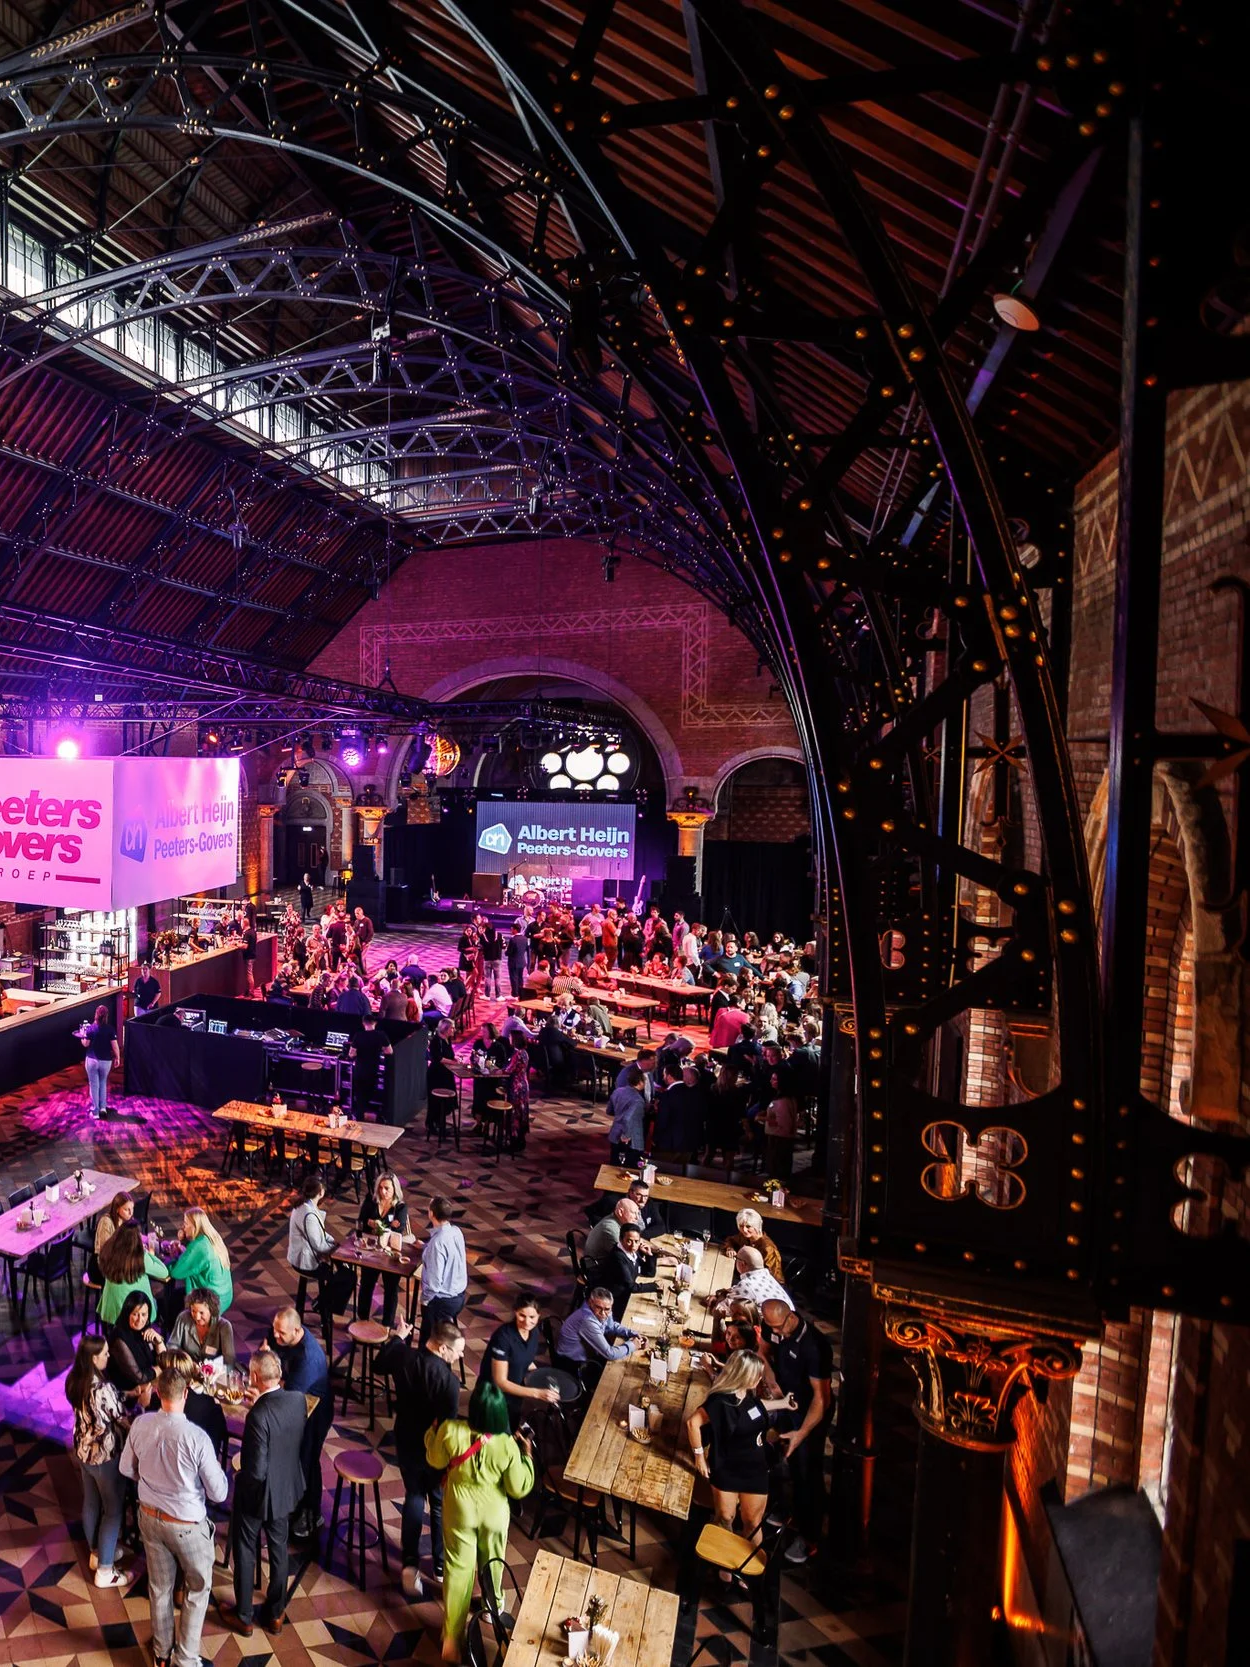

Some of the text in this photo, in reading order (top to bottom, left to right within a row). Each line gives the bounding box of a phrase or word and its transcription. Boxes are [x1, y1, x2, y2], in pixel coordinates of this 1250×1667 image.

[201, 796, 234, 827] Heijn
[153, 832, 233, 860] Peeters-Govers
[517, 824, 630, 846] Albert Heijn
[517, 842, 629, 858] Peeters-Govers
